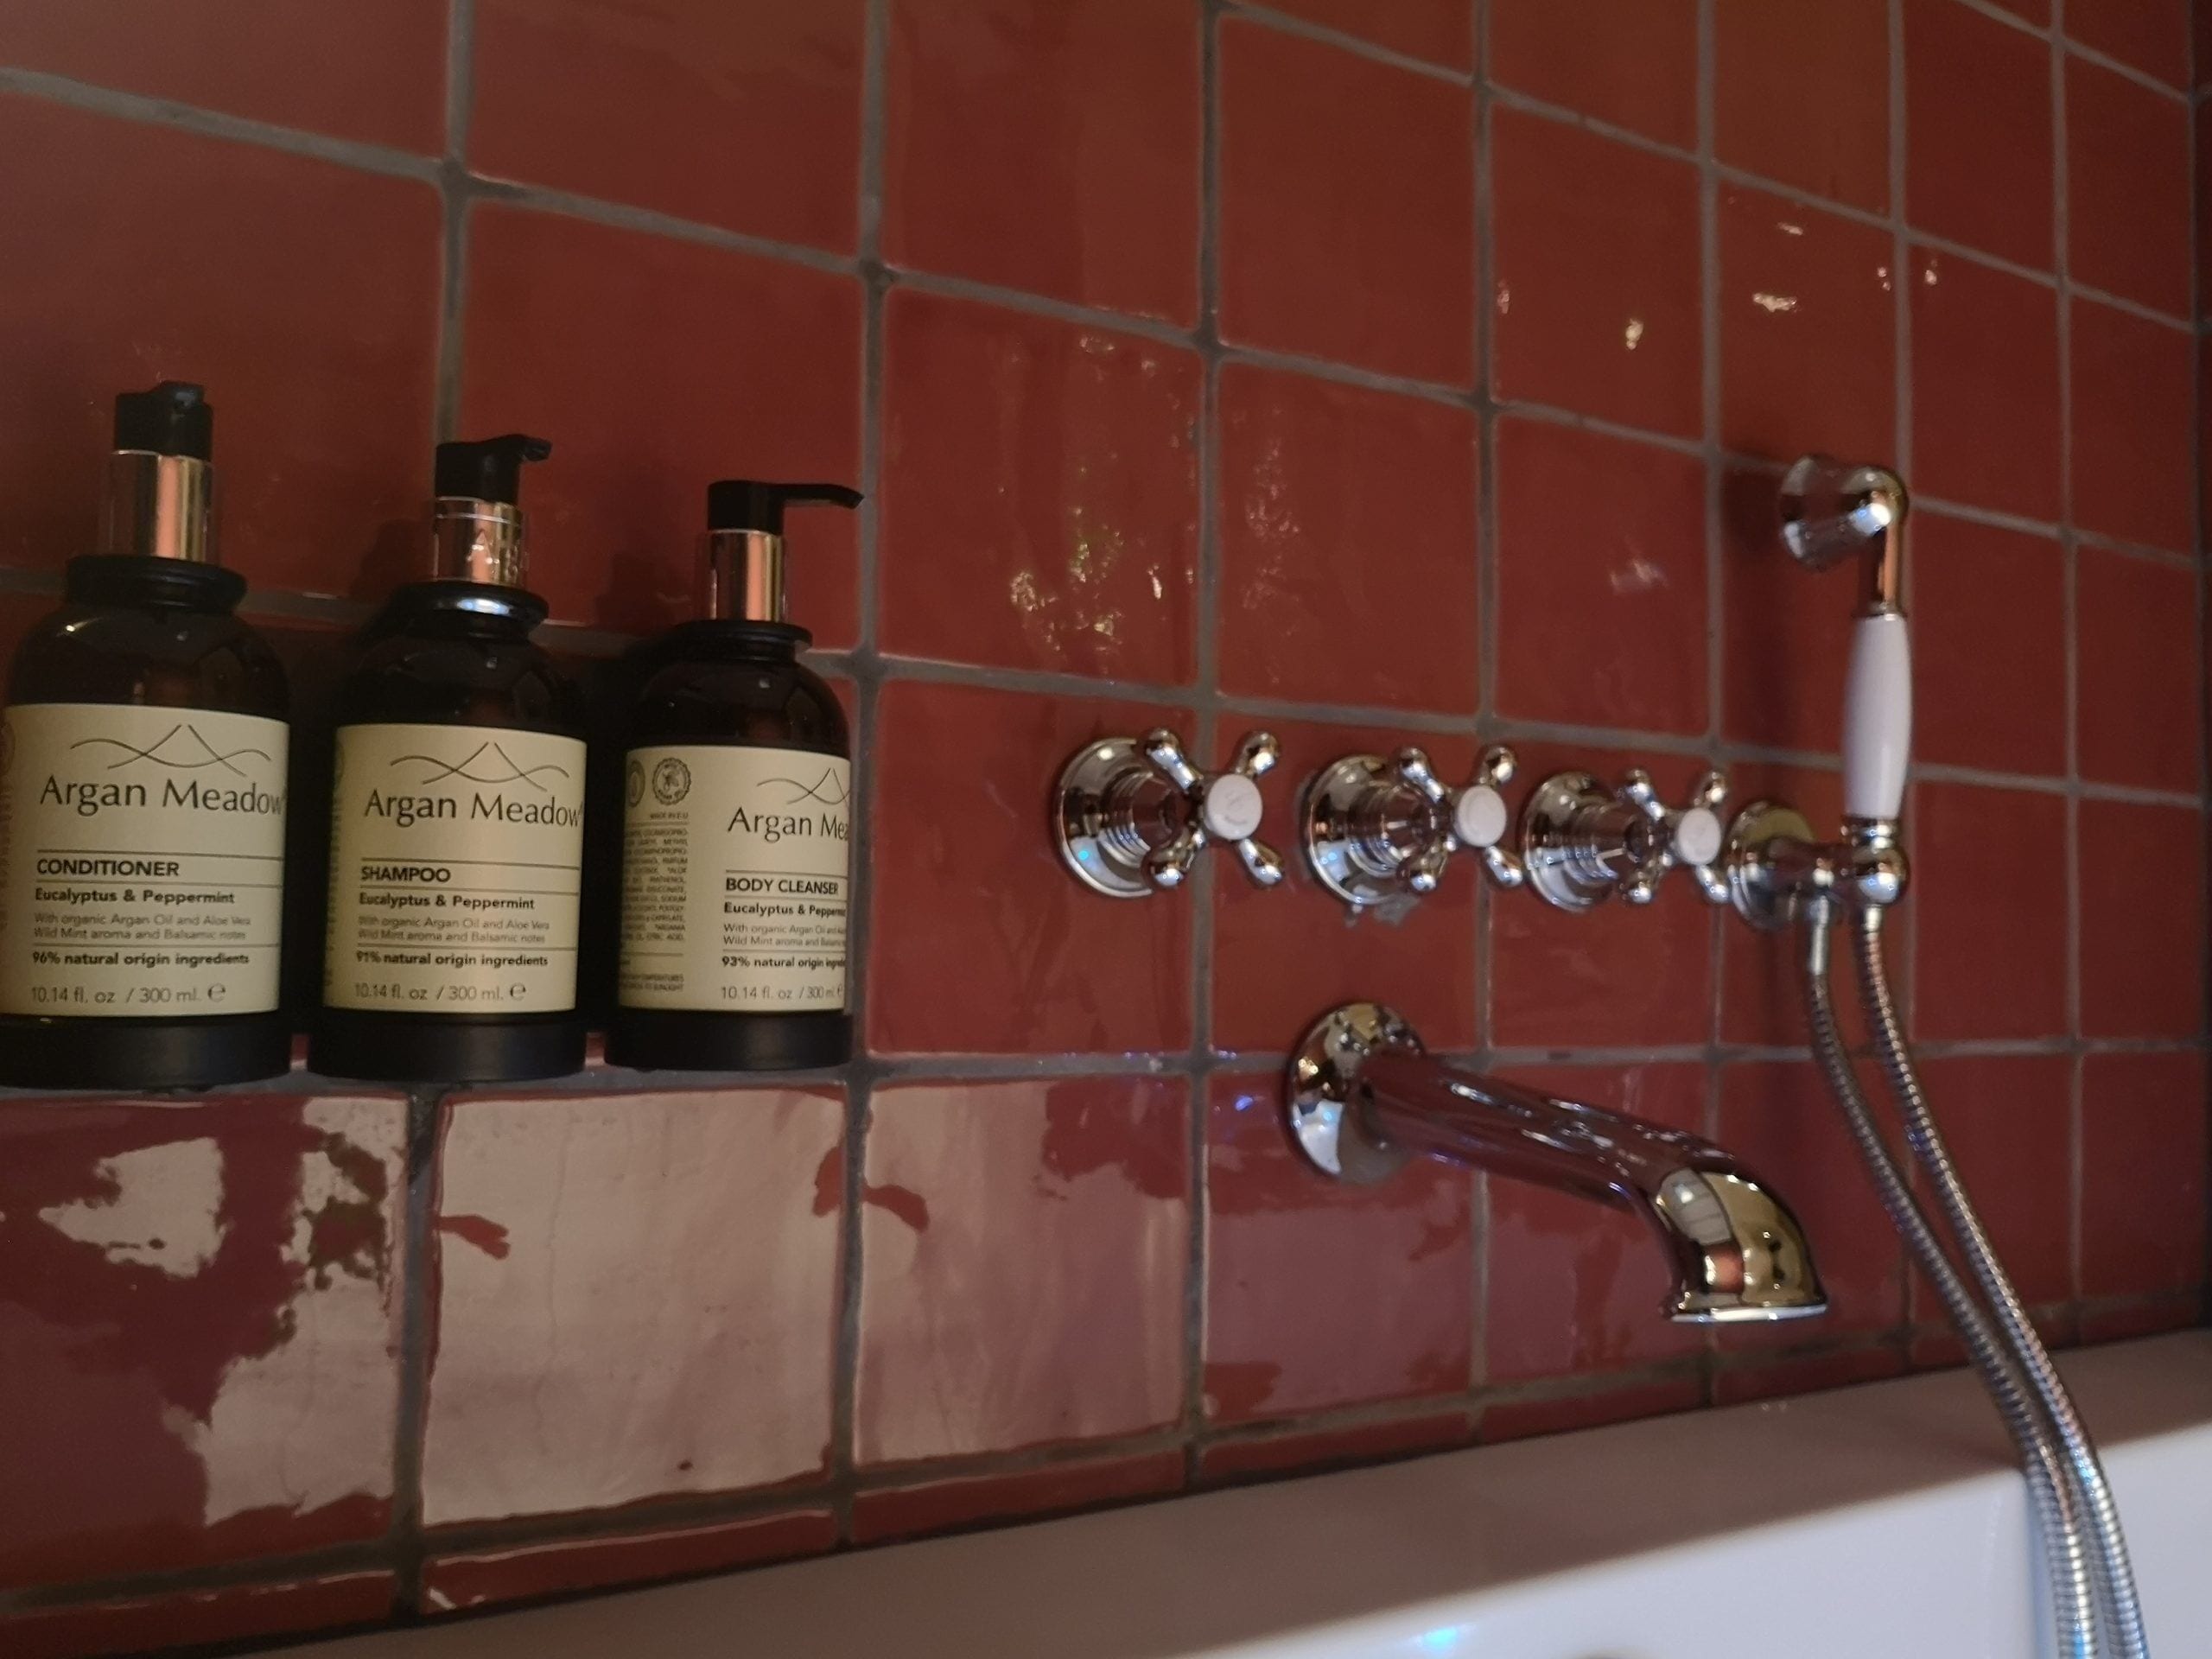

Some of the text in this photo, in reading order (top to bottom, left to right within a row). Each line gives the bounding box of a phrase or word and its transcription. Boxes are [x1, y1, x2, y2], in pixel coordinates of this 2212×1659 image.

[40, 775, 285, 817] Argan Meadow
[365, 788, 584, 828] Argan Meadow
[728, 805, 812, 843] Argan
[37, 859, 180, 877] CONDITIONER
[361, 866, 451, 883] SHAMPOO
[726, 878, 839, 895] BODY CLEANSER
[35, 887, 235, 906] Eucalyptus & Peppermint
[359, 892, 535, 912] Eucalyptus & Peppermint
[724, 902, 794, 917] Eucalyptus
[798, 904, 806, 914] &
[61, 913, 106, 927] organic
[111, 914, 150, 928] Argan
[154, 914, 173, 925] Oil
[177, 915, 199, 925] and
[381, 917, 420, 930] organic
[424, 917, 460, 930] Argan
[462, 918, 480, 928] Oil
[483, 918, 503, 929] and
[506, 918, 530, 929] Aloe
[60, 928, 87, 939] Mint
[91, 930, 131, 940] aroma
[135, 929, 160, 940] and
[407, 931, 442, 941] aroma
[446, 931, 467, 942] and
[471, 932, 518, 944] Balsamic
[723, 923, 748, 933] With
[751, 924, 787, 936] organic
[789, 925, 813, 936] Argan
[723, 935, 747, 945] Wild
[750, 936, 772, 946] Mint
[775, 938, 804, 947] aroma
[805, 938, 820, 947] and
[32, 951, 250, 969] 96% natural origin ingredients
[384, 952, 431, 966] natural
[435, 953, 477, 969] origin
[481, 955, 549, 969] ingredients
[721, 956, 752, 968] 93%
[753, 957, 795, 968] natural
[798, 958, 824, 970] origin
[31, 986, 68, 1002] 10.14
[94, 990, 117, 1003] oz
[124, 987, 135, 1003] /
[139, 987, 172, 1003] 300
[354, 982, 387, 998] 10.14
[409, 987, 429, 1001] oz
[435, 984, 445, 1001] /
[448, 985, 477, 1001] 300
[778, 988, 793, 1000] oz
[798, 986, 805, 1000] /
[807, 985, 825, 1000] 300
